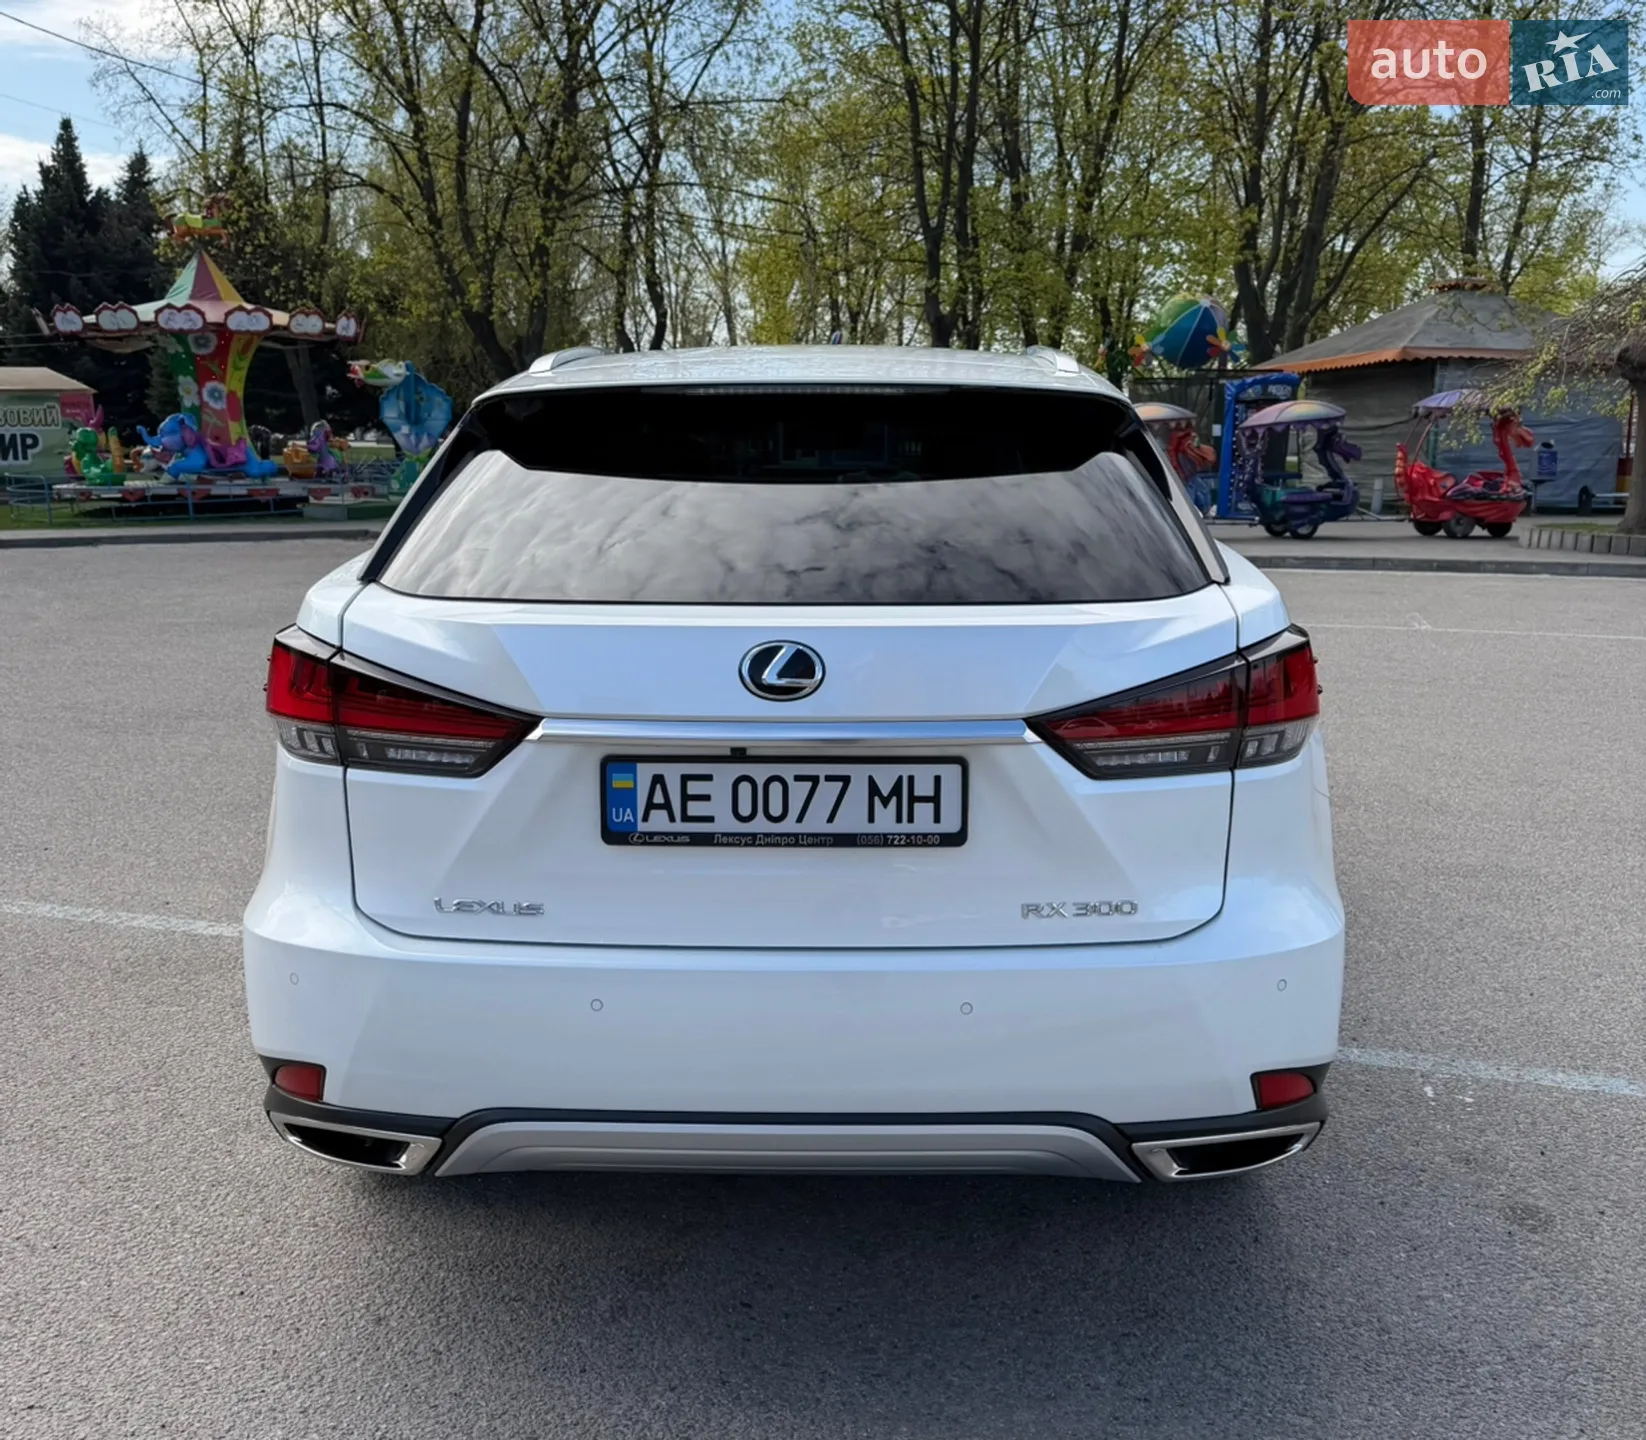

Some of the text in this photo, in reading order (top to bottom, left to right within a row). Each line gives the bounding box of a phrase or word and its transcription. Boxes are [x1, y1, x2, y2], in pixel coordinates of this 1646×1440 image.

[641, 773, 942, 824] AE 0077 MH
[612, 807, 635, 823] UA
[645, 834, 691, 843] LEXUS
[713, 833, 834, 847] Лексус Дніпро Центр
[857, 834, 941, 846] (056) 722-10-00
[433, 896, 546, 917] LEXUS
[1021, 900, 1139, 920] RX 300
